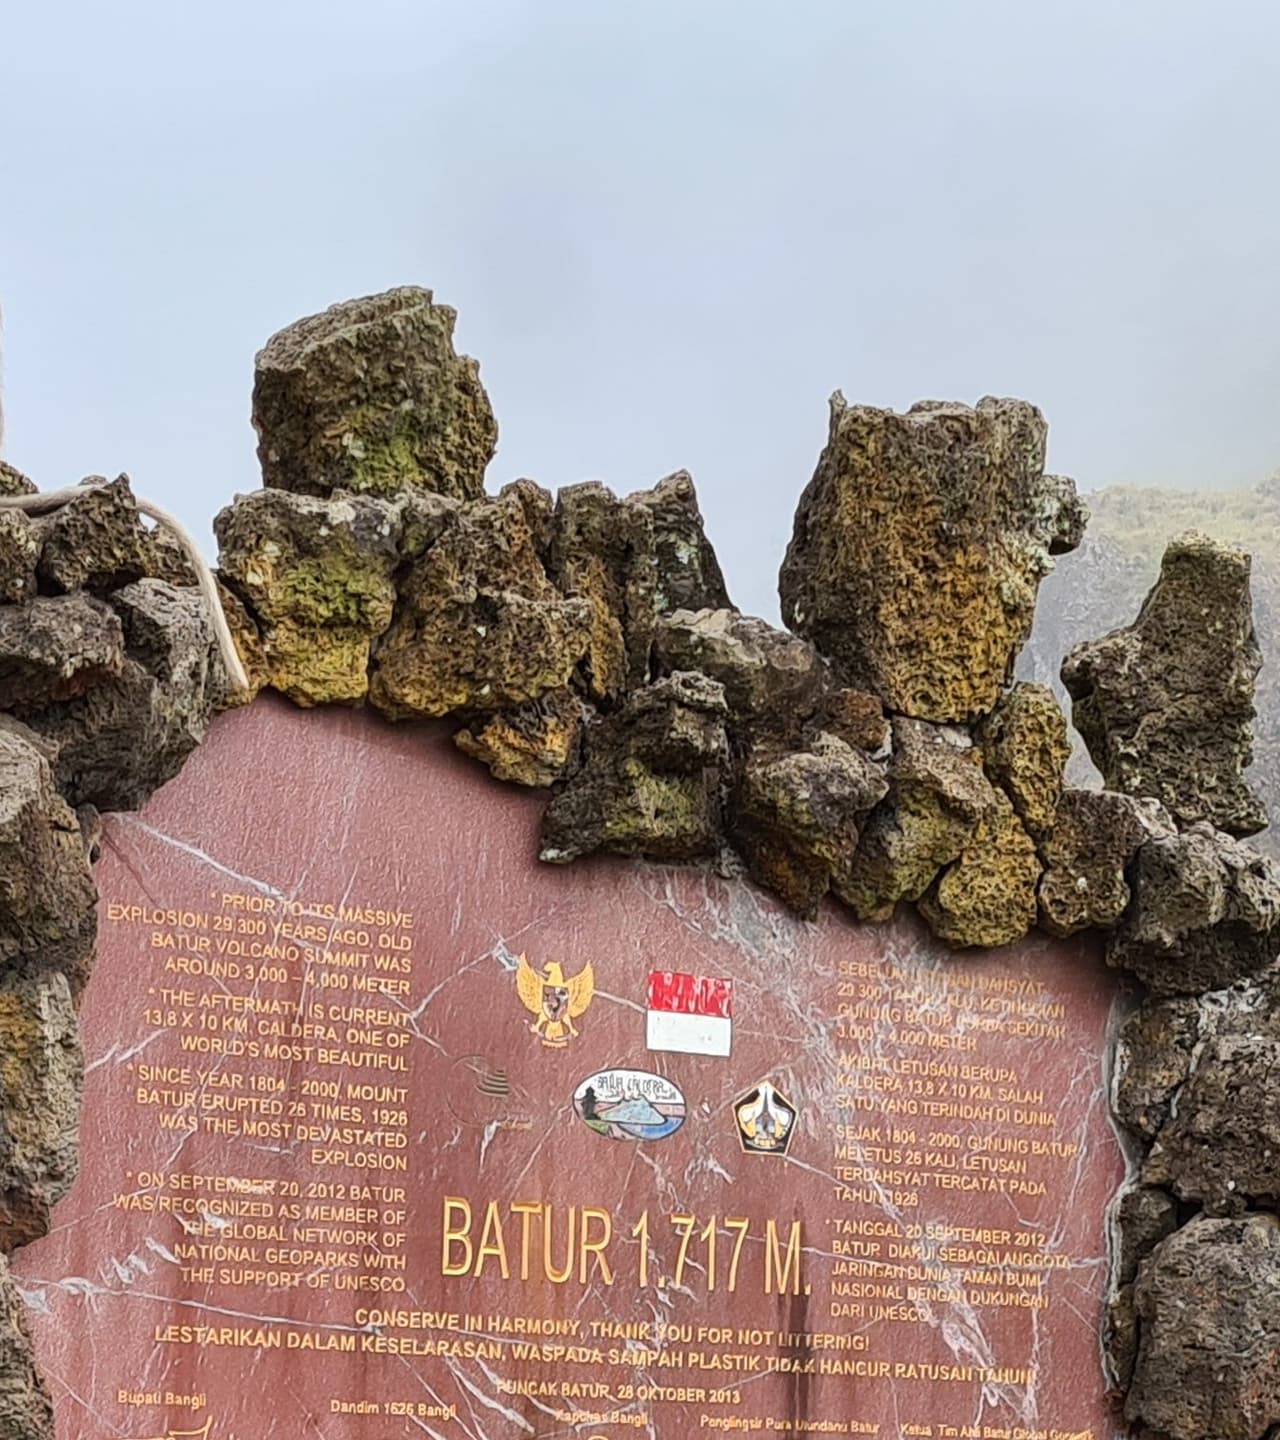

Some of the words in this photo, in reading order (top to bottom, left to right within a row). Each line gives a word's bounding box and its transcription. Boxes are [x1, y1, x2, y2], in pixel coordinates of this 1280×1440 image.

[222, 893, 276, 914] PRIOR
[281, 901, 303, 916] TO
[308, 903, 335, 920] ITS
[339, 906, 413, 928] MASSIVE
[107, 903, 208, 929] EXPLOSION
[270, 921, 327, 942] YEARS
[379, 934, 412, 951] OLD
[151, 932, 210, 952] BATUR
[216, 938, 299, 962] VOLCANO
[304, 947, 370, 969] SUMMIT
[374, 955, 411, 973] WAS
[165, 957, 240, 978] AROUND
[353, 975, 410, 995] METER
[160, 988, 195, 1007] THE
[199, 994, 303, 1016] AFTERMATH
[309, 1004, 324, 1019] IS
[329, 1006, 410, 1027] CURRENT
[182, 1012, 194, 1028] X
[199, 1015, 217, 1030] 10
[346, 1028, 383, 1045] ONE
[386, 1032, 410, 1049] OF
[180, 1035, 259, 1057] WORLD'S
[264, 1043, 314, 1062] MOST
[318, 1049, 408, 1071] BEAUTIFUL
[138, 1064, 191, 1085] SINCE
[196, 1070, 244, 1089] YEAR
[250, 1076, 285, 1092] 1804
[347, 1084, 408, 1103] MOUNT
[893, 1059, 958, 1078] LETUSAN
[961, 1065, 1017, 1084] BERUPA
[836, 1074, 902, 1092] KALDERA
[951, 1083, 967, 1098] 10
[999, 1087, 1043, 1105] SALAH
[137, 1087, 195, 1107] BATUR
[201, 1094, 283, 1115] ERUPTED
[288, 1101, 306, 1117] 26
[372, 1109, 408, 1126] 1926
[836, 1094, 874, 1111] SATU
[879, 1098, 918, 1115] YANG
[920, 1101, 993, 1120] TERINDAH
[996, 1108, 1010, 1122] DI
[1014, 1110, 1056, 1127] DUNIA
[159, 1113, 198, 1131] WAS
[204, 1117, 238, 1134] THE
[243, 1122, 292, 1139] MOST
[297, 1125, 407, 1148] DEVASTATED
[836, 1125, 881, 1142] SEJAK
[886, 1130, 916, 1144] 1804
[967, 1135, 1028, 1154] GUNUNG
[1032, 1141, 1077, 1157] BATUR
[312, 1149, 407, 1170] EXPLOSION
[834, 1144, 902, 1164] MELETUS
[963, 1154, 1026, 1174] LETUSAN
[138, 1172, 164, 1188] ON
[170, 1174, 275, 1195] SEPTEMBER
[308, 1183, 346, 1199] 2012
[350, 1185, 406, 1203] BATUR
[834, 1166, 931, 1186] TERDAHSYAT
[933, 1173, 1006, 1193] TERCATAT
[1010, 1181, 1047, 1196] PADA
[113, 1194, 154, 1210] WAS
[159, 1197, 273, 1217] RECOGNIZED
[278, 1204, 301, 1220] AS
[305, 1205, 378, 1223] MEMBER
[383, 1210, 406, 1225] OF
[183, 1221, 216, 1236] THE
[221, 1223, 288, 1241] GLOBAL
[293, 1228, 378, 1246] NETWORK
[383, 1232, 406, 1248] OF
[441, 1195, 615, 1286] BATUR
[632, 1210, 750, 1294] 1.717
[833, 1219, 903, 1238] TANGGAL
[906, 1224, 922, 1239] 20
[926, 1225, 1011, 1245] SEPTEMBER
[1015, 1232, 1046, 1248] 2012
[174, 1243, 260, 1263] NATIONAL
[265, 1248, 359, 1268] GEOPARKS
[363, 1253, 406, 1270] WITH
[888, 1244, 935, 1261] DIAKUI
[939, 1247, 999, 1264] SEBAGAI
[1003, 1250, 1071, 1269] ANGGOTA
[180, 1267, 214, 1283] THE
[220, 1269, 304, 1287] SUPPORT
[306, 1273, 330, 1288] OF
[335, 1274, 406, 1292] UNESCO
[831, 1262, 904, 1279] JARINGAN
[907, 1266, 951, 1282] DUNIA
[955, 1269, 1002, 1285] TAMAN
[1006, 1272, 1041, 1288] BUMI
[831, 1281, 904, 1300] NASIONAL
[907, 1286, 967, 1304] DENGAN
[970, 1290, 1049, 1309] DUKUNGAN
[830, 1302, 865, 1318] DARI
[869, 1305, 930, 1322] UNESCO
[355, 1308, 459, 1330] CONSERVE
[464, 1314, 482, 1332] IN
[487, 1315, 585, 1339] HARMONY,
[590, 1321, 651, 1340] THANK
[658, 1324, 693, 1343] YOU
[697, 1326, 733, 1344] FOR
[737, 1328, 774, 1346] NOT
[778, 1331, 870, 1350] LITTERING!
[154, 1325, 281, 1348] LESTARIKAN
[287, 1332, 355, 1352] DALAM
[361, 1336, 507, 1361] KESELARASAN,
[512, 1343, 604, 1364] WASPADA
[608, 1348, 683, 1368] SAMPAH
[688, 1352, 761, 1372] PLASTIK
[765, 1356, 816, 1374] TIDAK
[820, 1359, 890, 1377] HANCUR
[895, 1362, 972, 1382] RATUSAN
[977, 1367, 1035, 1385] TAHUN
[118, 1389, 161, 1408] Bupati
[165, 1392, 207, 1411] Bangli
[330, 1399, 379, 1415] Dandim
[496, 1380, 558, 1397] PUNCAK
[617, 1385, 634, 1399] 28
[637, 1385, 706, 1403] OKTOBER
[709, 1389, 741, 1404] 2013
[938, 1425, 957, 1438] Tim
